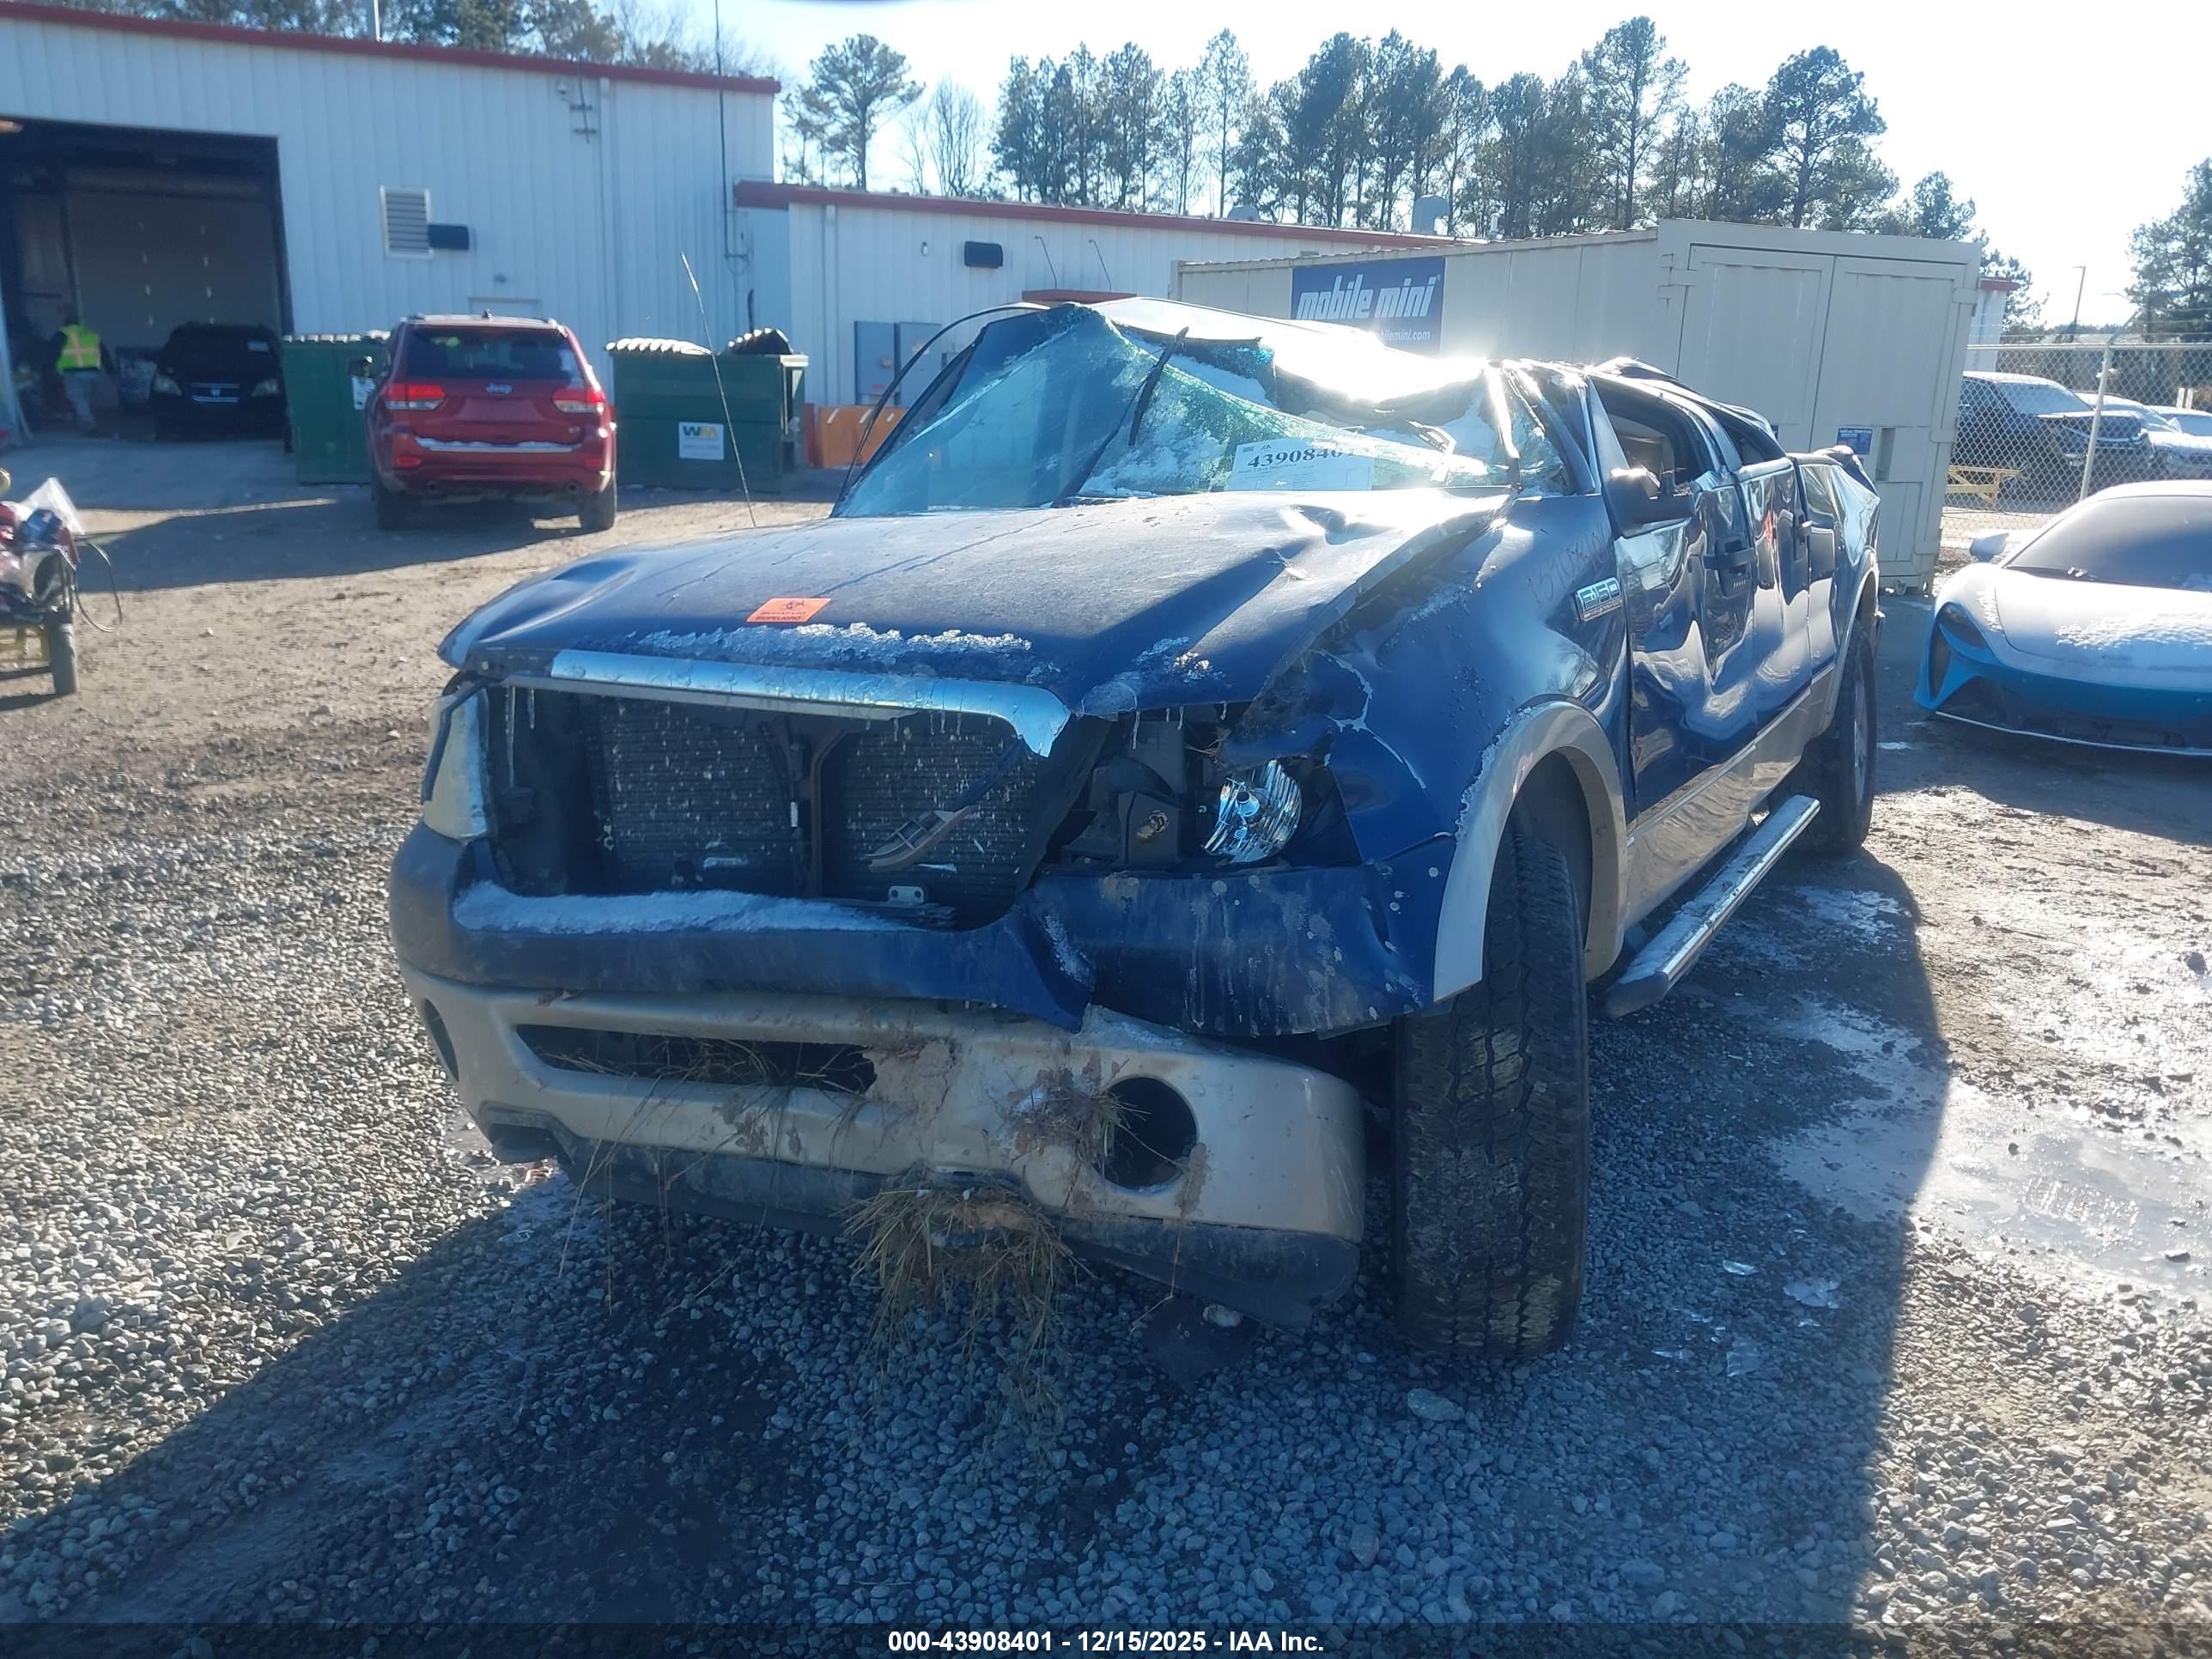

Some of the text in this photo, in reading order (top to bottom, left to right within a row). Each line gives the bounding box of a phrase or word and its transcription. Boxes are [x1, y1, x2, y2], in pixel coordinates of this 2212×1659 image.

[1297, 275, 1437, 320] mobile mini
[1381, 329, 1431, 343] bilemini.com
[485, 384, 513, 394] Jeep
[683, 426, 718, 438] WM
[1248, 447, 1354, 468] 4390840
